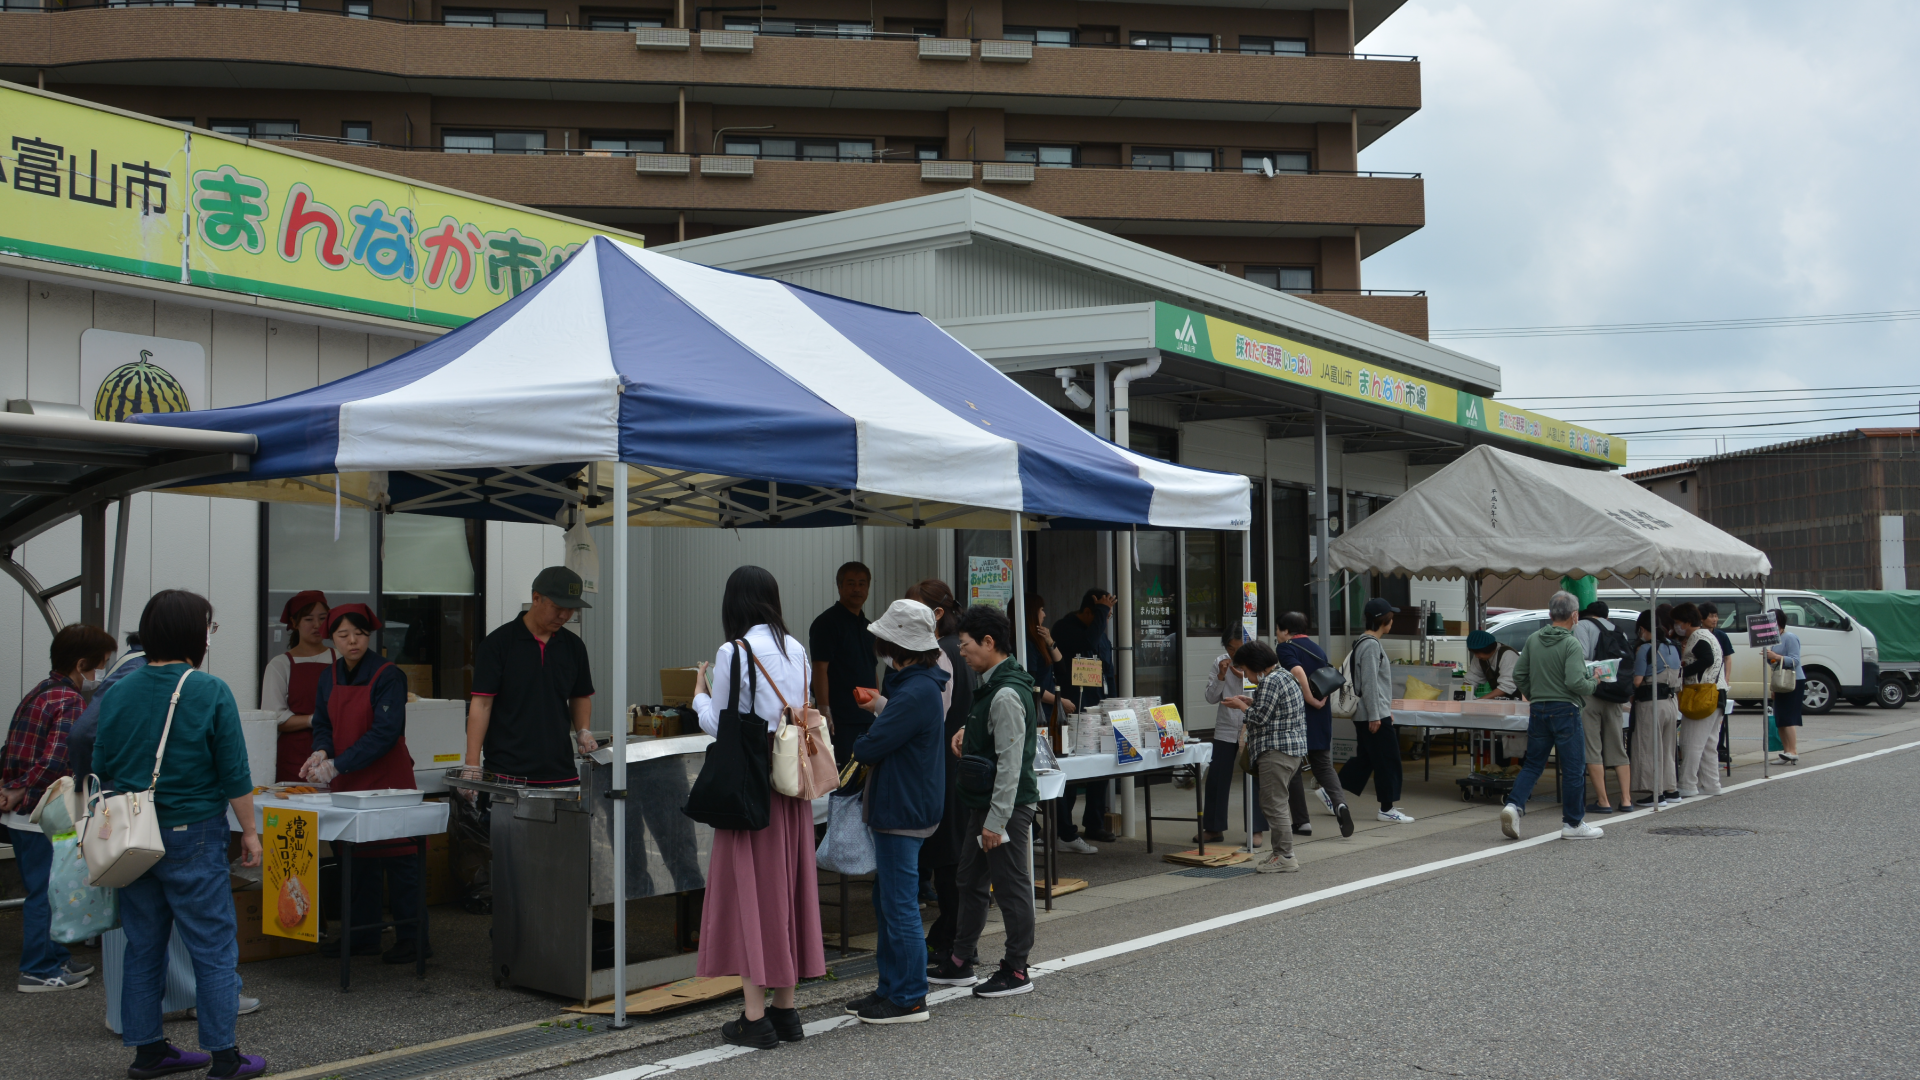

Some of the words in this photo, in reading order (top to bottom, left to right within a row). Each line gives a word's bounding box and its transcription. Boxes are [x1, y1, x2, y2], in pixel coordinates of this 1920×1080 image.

[1320, 363, 1353, 387] JA富山市
[1359, 367, 1427, 412] まんなか市場
[1568, 428, 1610, 459] まんなか市場
[1490, 488, 1498, 529] 平成元年八月
[1140, 606, 1170, 616] まんなか市場
[293, 815, 307, 851] 富山
[276, 834, 292, 881] コロッケ
